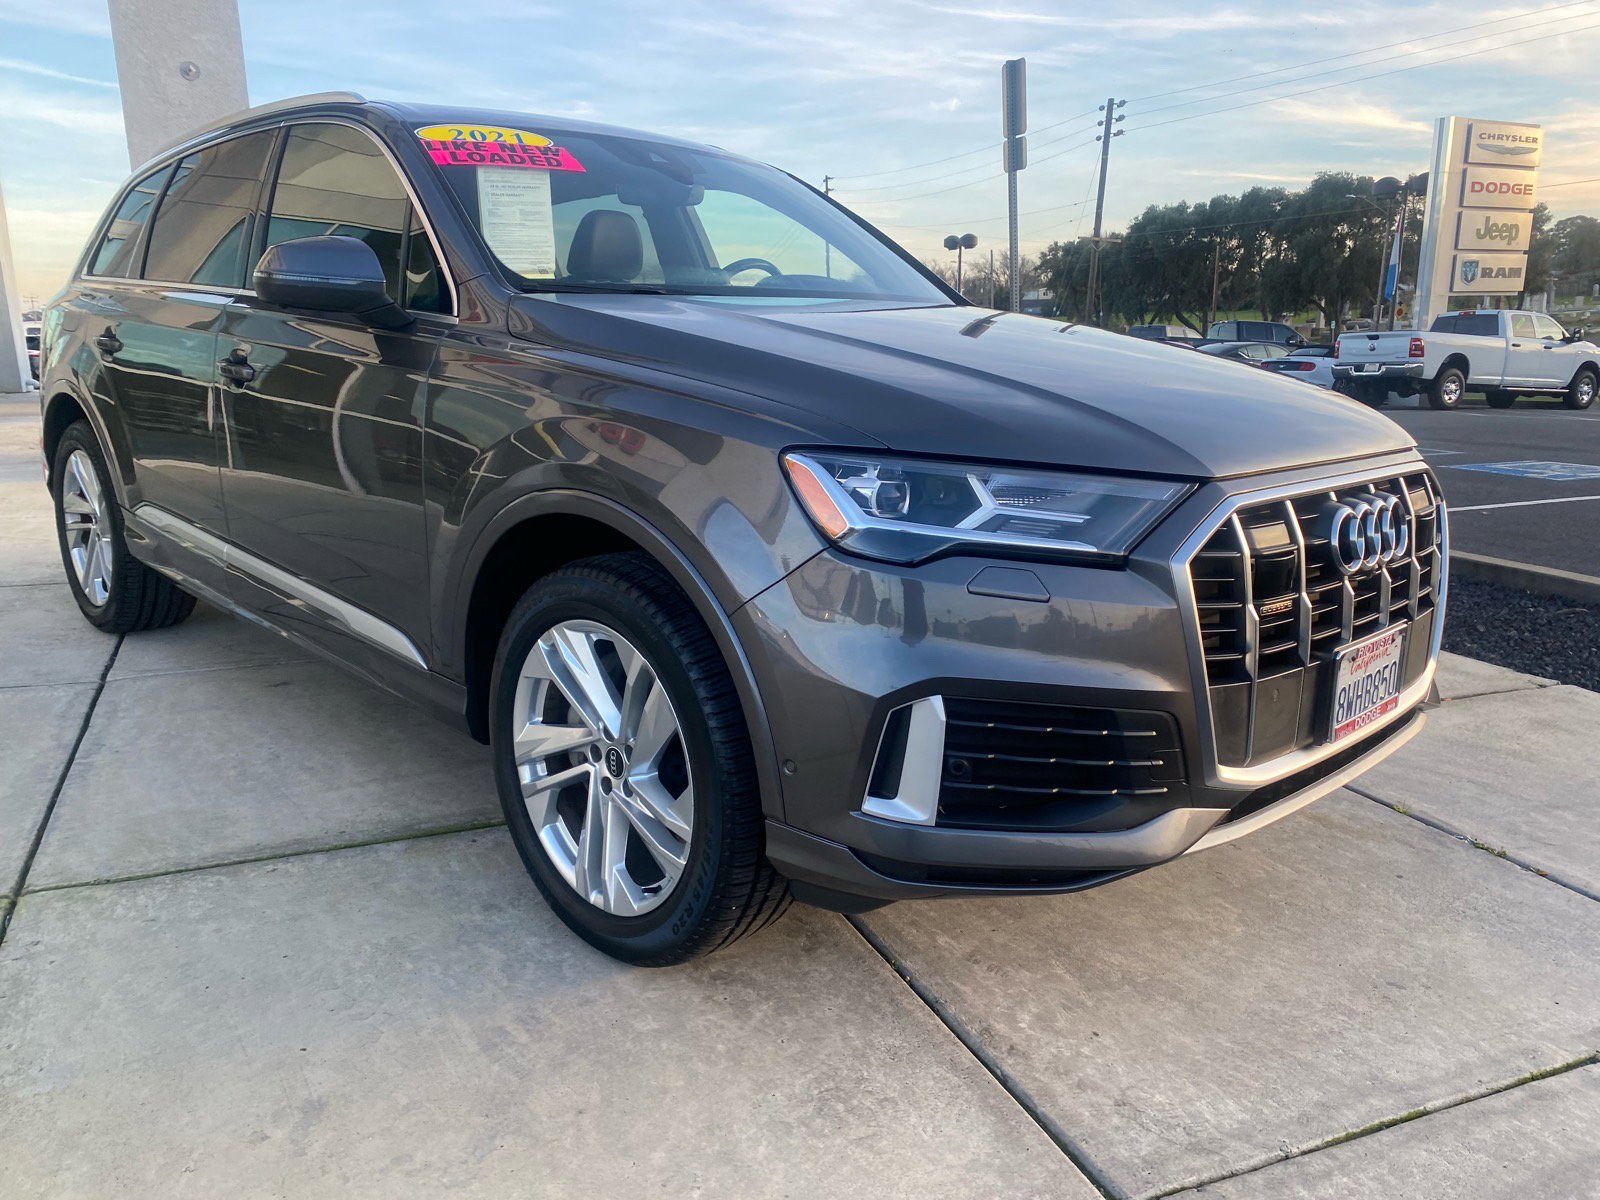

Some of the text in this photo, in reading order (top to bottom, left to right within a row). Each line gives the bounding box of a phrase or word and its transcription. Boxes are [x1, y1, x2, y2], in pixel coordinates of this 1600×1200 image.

[448, 128, 525, 145] 2021
[1478, 132, 1538, 144] CHRYSLER
[424, 140, 561, 157] LIKE NEW
[451, 151, 564, 167] LOADED
[1470, 181, 1533, 196] DODGE
[1476, 216, 1520, 245] Jeep
[1480, 267, 1522, 279] RAM
[1336, 661, 1398, 723] 8WHB850
[1355, 706, 1381, 729] DODGE
